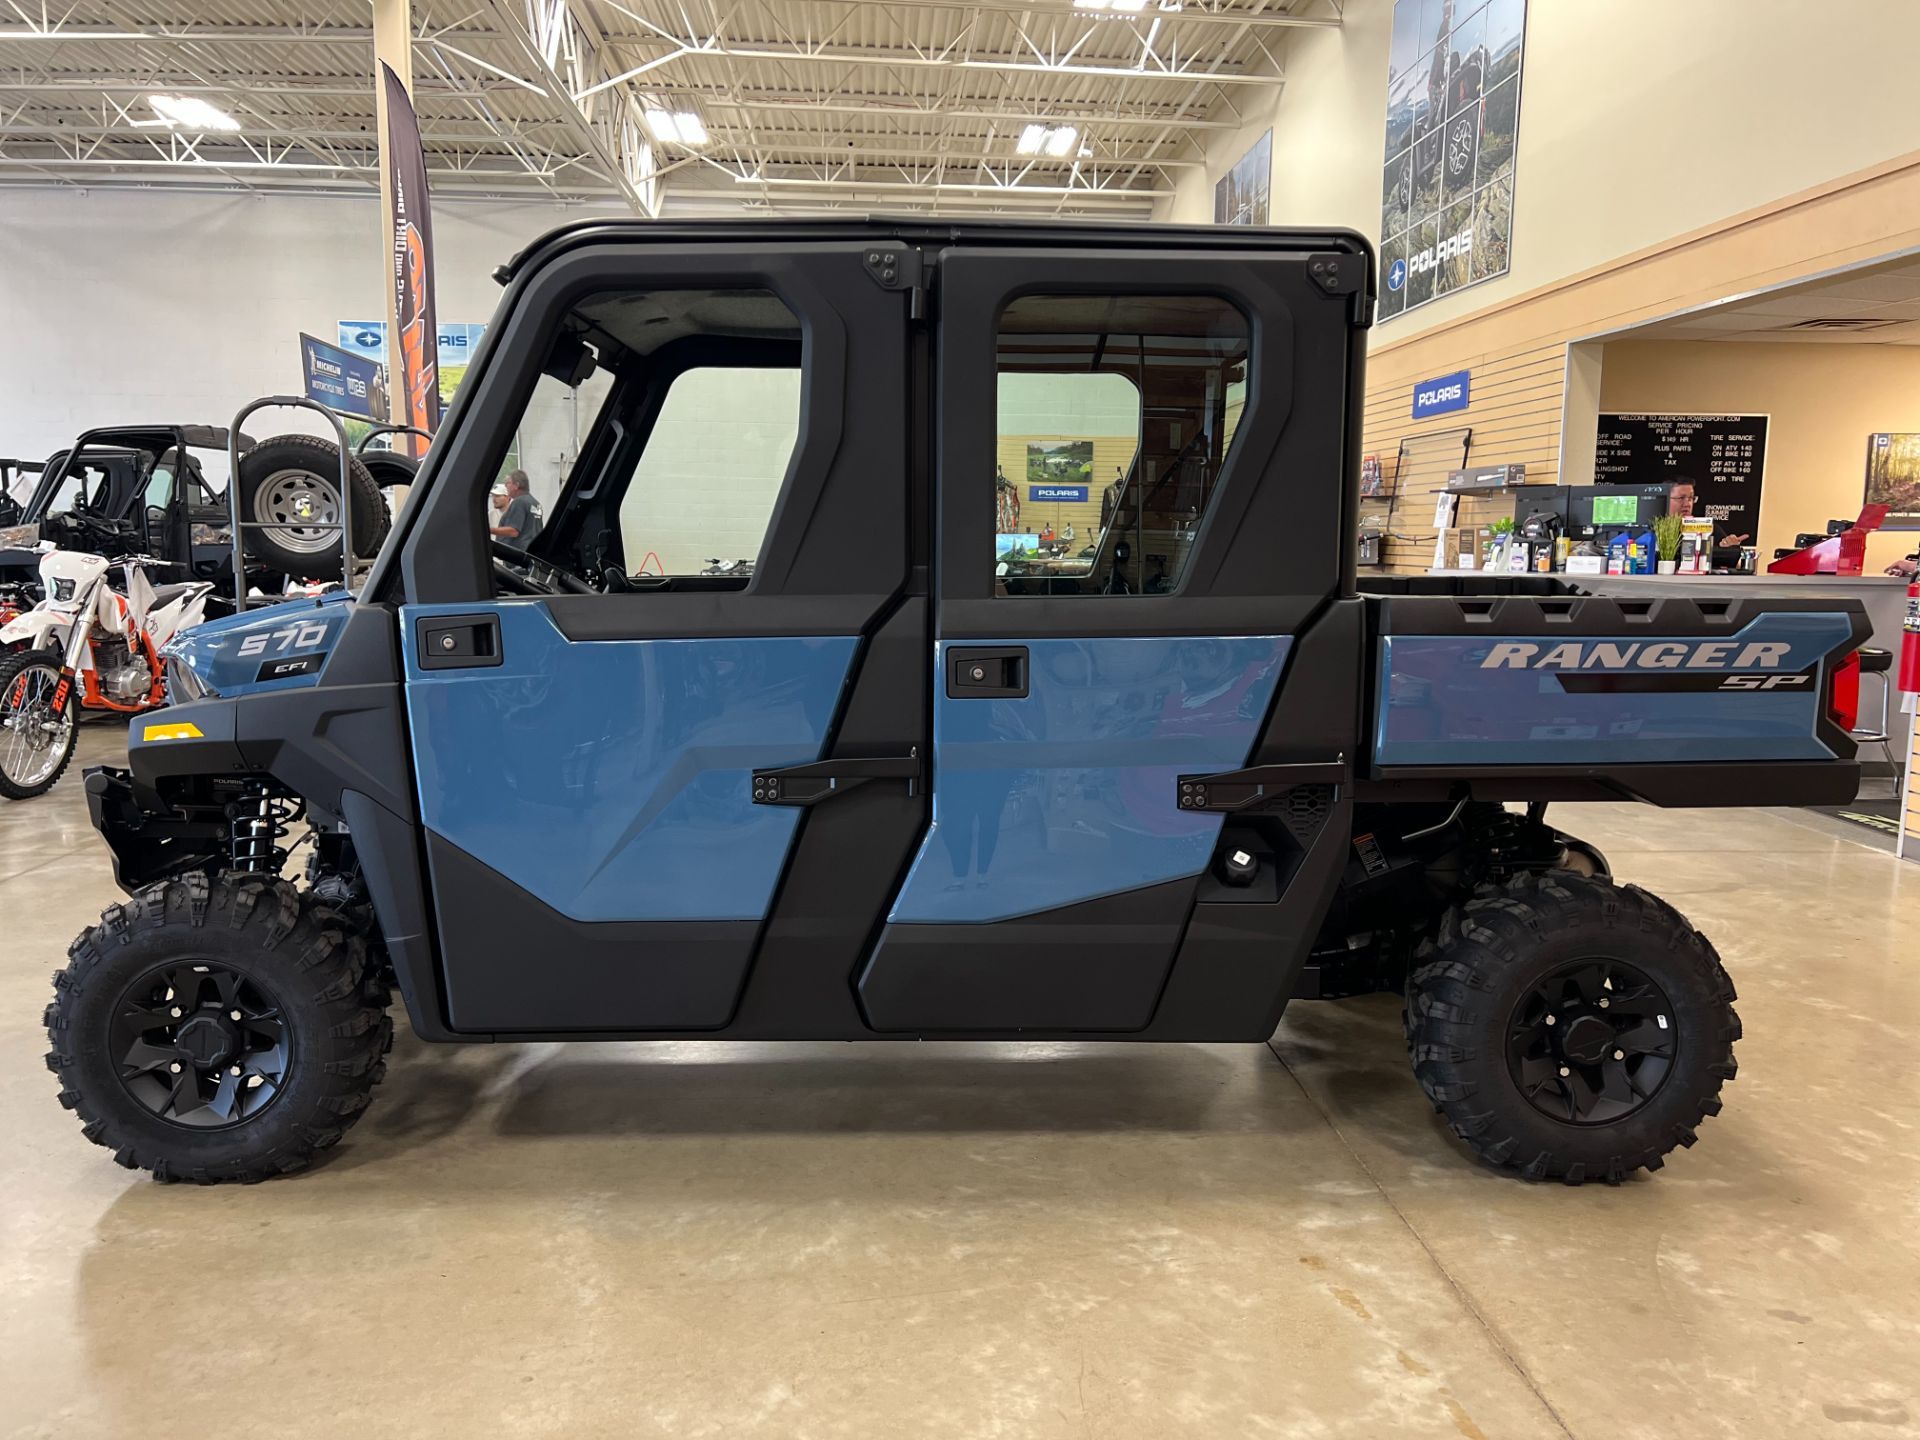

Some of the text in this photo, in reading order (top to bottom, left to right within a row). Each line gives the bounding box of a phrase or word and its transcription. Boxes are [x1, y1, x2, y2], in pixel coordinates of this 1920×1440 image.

[1409, 228, 1473, 278] POLARIS
[316, 359, 341, 376] MICHELIN
[312, 379, 335, 394] MOTORCYCLE
[1418, 384, 1461, 407] POLARIS
[237, 624, 328, 657] 570
[274, 661, 308, 673] EFI
[1480, 642, 1791, 669] RANGER
[1717, 675, 1810, 690] SP
[52, 679, 71, 714] 230
